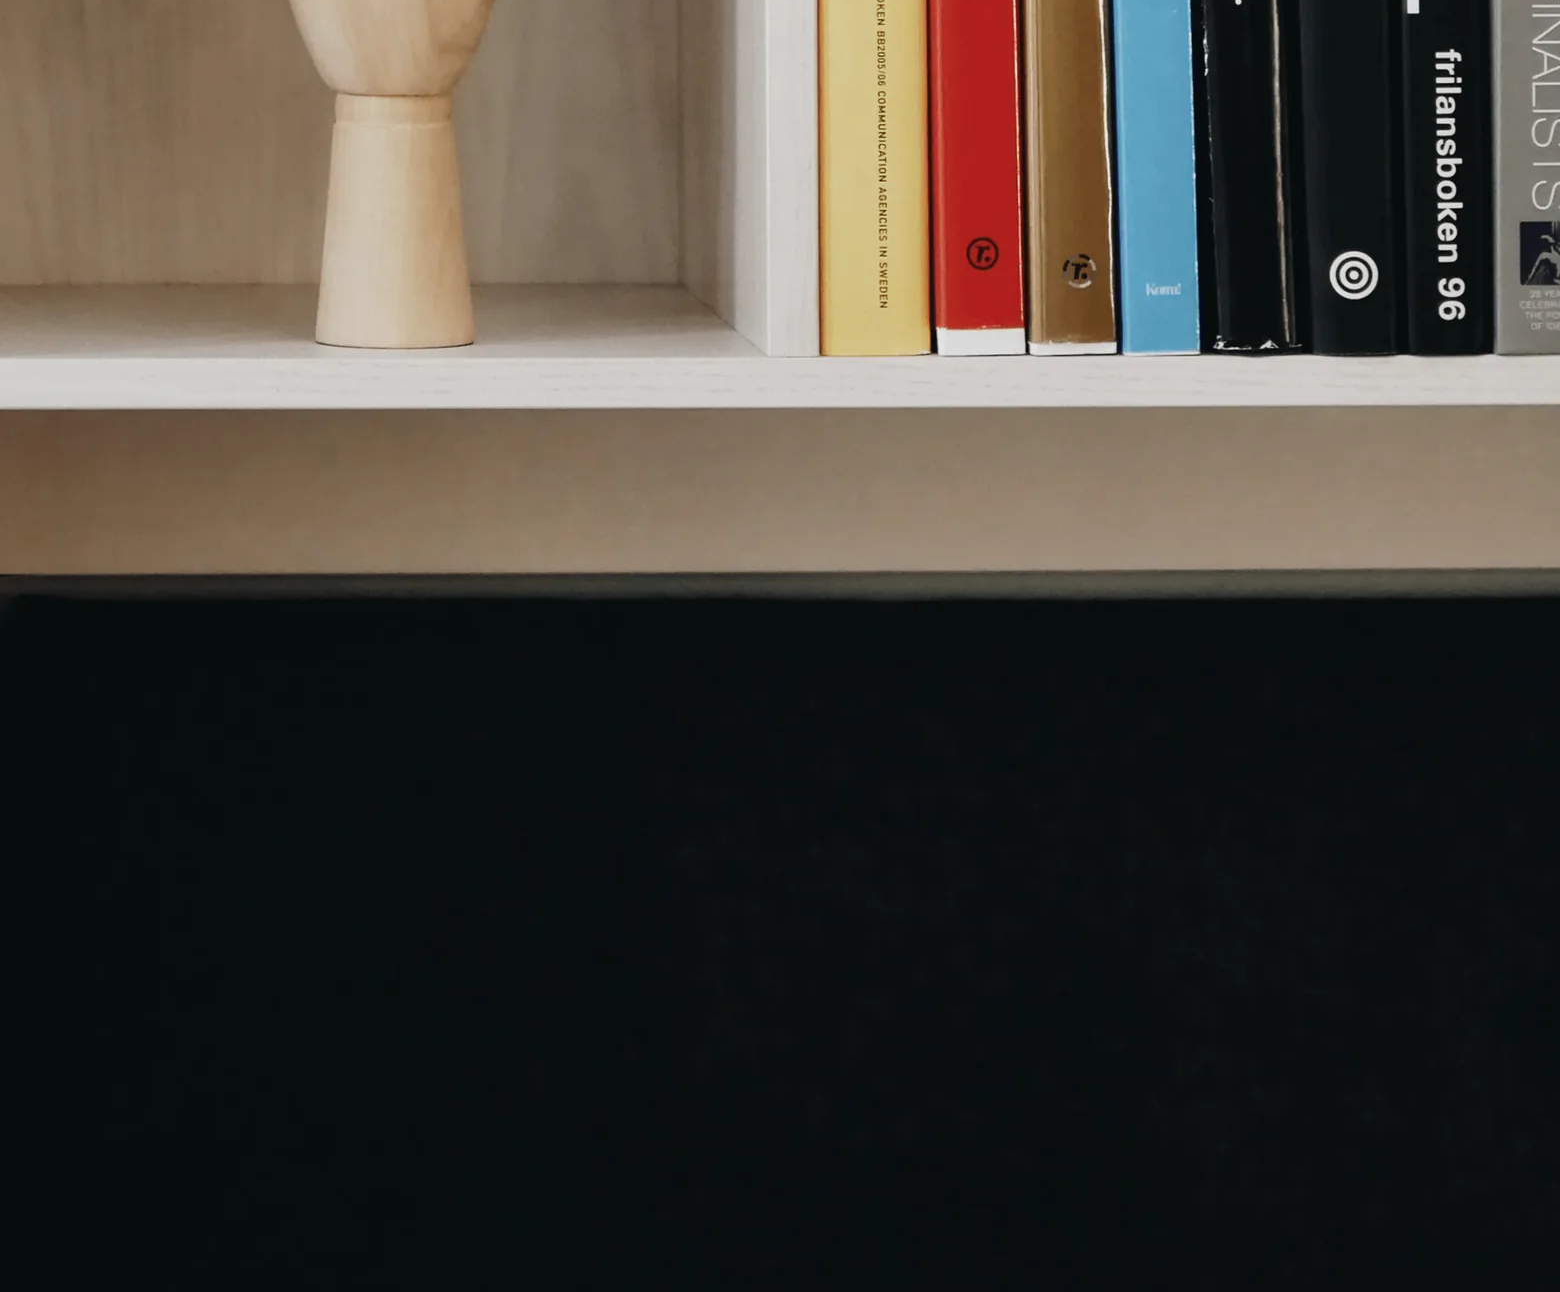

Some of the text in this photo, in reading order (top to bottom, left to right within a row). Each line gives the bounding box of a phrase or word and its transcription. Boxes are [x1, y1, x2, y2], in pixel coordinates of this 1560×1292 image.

[877, 30, 887, 86] BB2005/06
[877, 90, 888, 182] COMMUNICATION
[1435, 49, 1467, 321] frilansboken 96
[878, 187, 888, 242] AGENCIES
[878, 246, 887, 258] IN
[878, 262, 888, 309] SWEDEN
